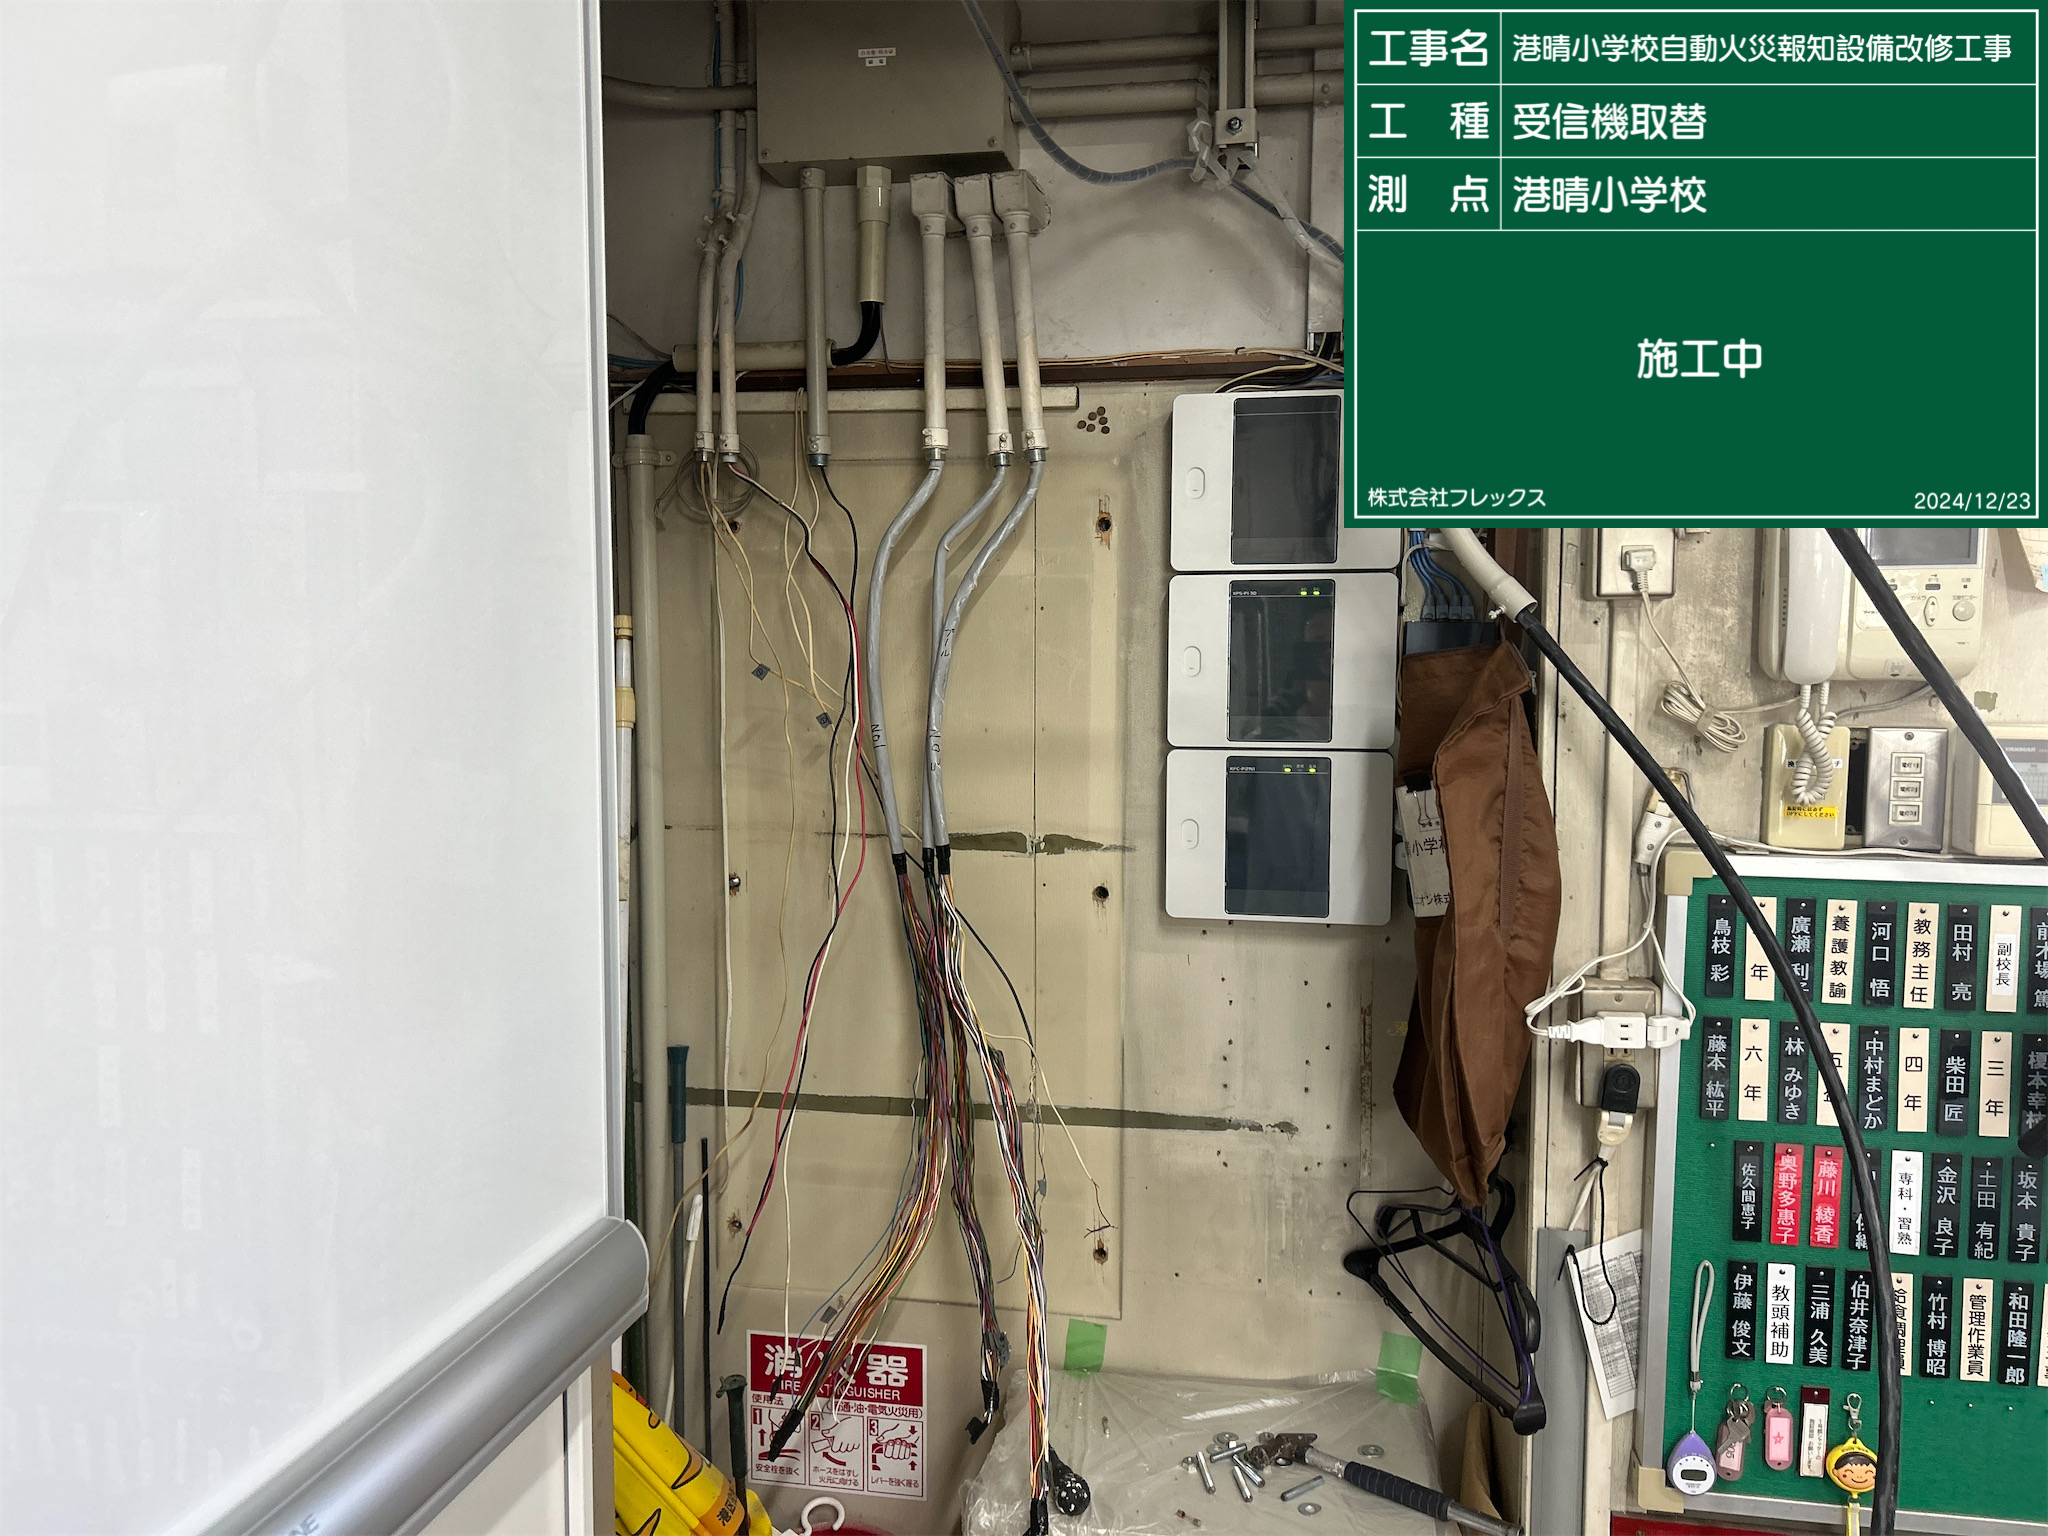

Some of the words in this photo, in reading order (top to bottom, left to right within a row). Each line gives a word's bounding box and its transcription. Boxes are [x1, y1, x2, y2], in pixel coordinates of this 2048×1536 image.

[1829, 915, 1850, 998] 養護教諭
[1910, 918, 1931, 1003] 教務主任
[1995, 942, 2012, 987] 副校長
[1743, 1045, 1763, 1102] 六年
[1863, 1037, 1884, 1130] 中村まどか
[1904, 1056, 1923, 1112] 四年
[1985, 1060, 2004, 1117] 三年
[1740, 1163, 1757, 1230] 佐久間恵子
[1770, 1284, 1791, 1358] 教頭補助
[1846, 1280, 1870, 1370] 伯井奈津子
[1967, 1294, 1987, 1377] 管理作業員
[2004, 1292, 2029, 1385] 和田隆一郎
[772, 1379, 802, 1392] IRE
